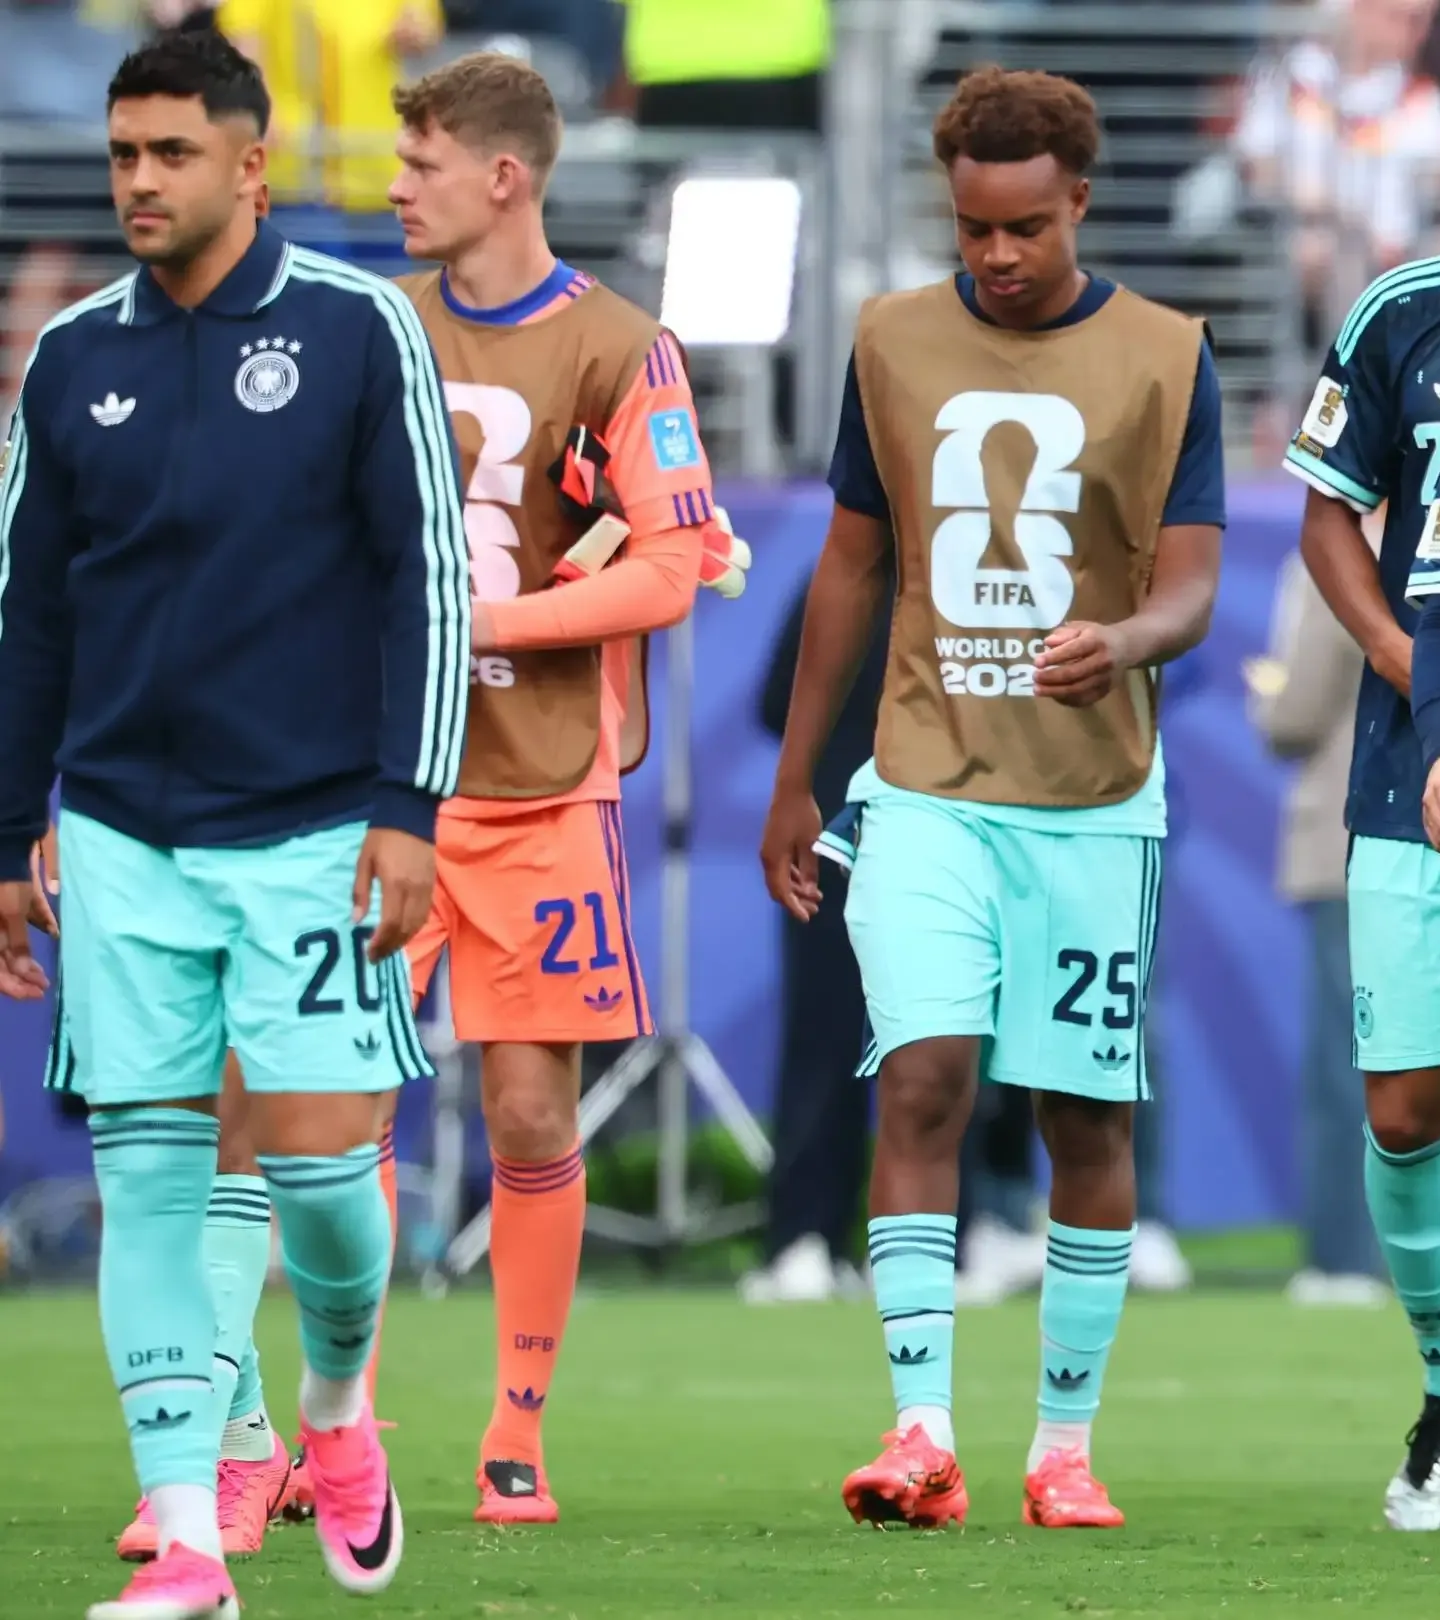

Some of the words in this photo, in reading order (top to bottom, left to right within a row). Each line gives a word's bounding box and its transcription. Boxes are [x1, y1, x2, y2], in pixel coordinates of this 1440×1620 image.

[974, 583, 1036, 607] FIFA
[934, 637, 1024, 659] WORLD
[940, 662, 1040, 697] 202
[534, 892, 619, 974] 21
[1052, 948, 1137, 1030] 25
[514, 1333, 556, 1353] DFB
[128, 1345, 184, 1368] DFB
